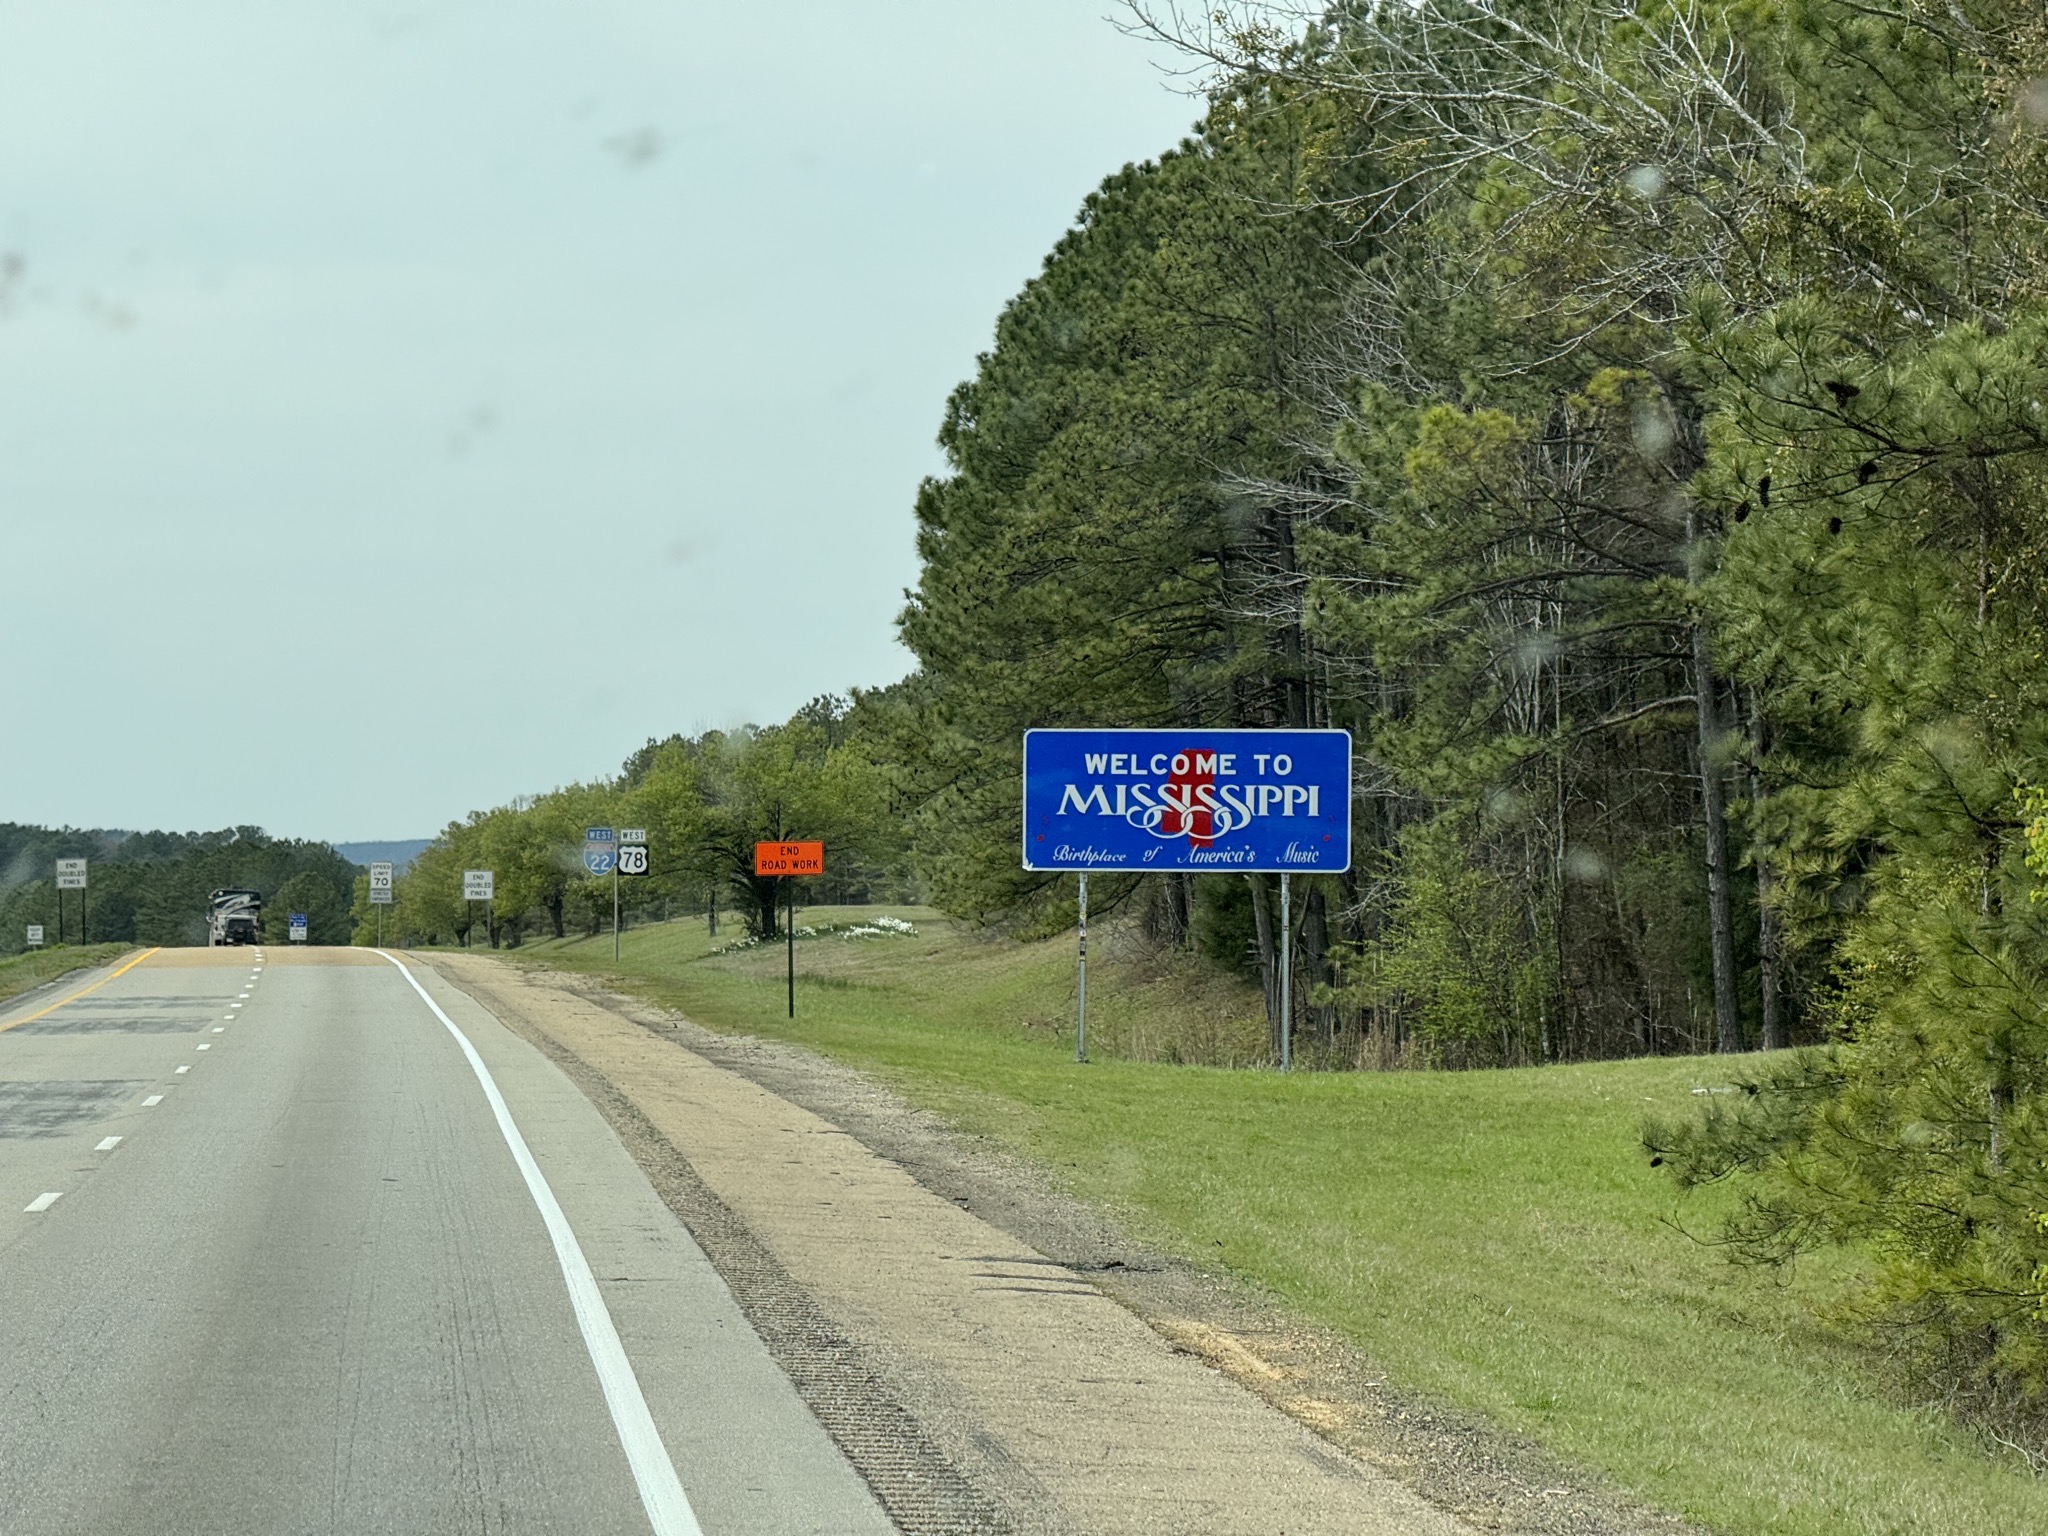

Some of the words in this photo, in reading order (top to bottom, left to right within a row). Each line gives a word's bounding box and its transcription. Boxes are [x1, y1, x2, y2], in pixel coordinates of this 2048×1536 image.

[1084, 754, 1237, 775] WELCOME
[1253, 754, 1293, 775] TO
[1056, 783, 1321, 839] MISSISSIPPI
[589, 831, 612, 839] WEST
[622, 831, 644, 840] WEST
[780, 846, 799, 856] END
[1053, 845, 1127, 866] Birthplace
[1142, 846, 1163, 862] of
[1177, 844, 1257, 864] America's
[1276, 841, 1320, 864] Music
[590, 855, 610, 870] 22
[623, 852, 643, 868] 78
[761, 860, 787, 870] ROAD
[792, 859, 819, 870] WORK
[374, 877, 389, 886] 70
